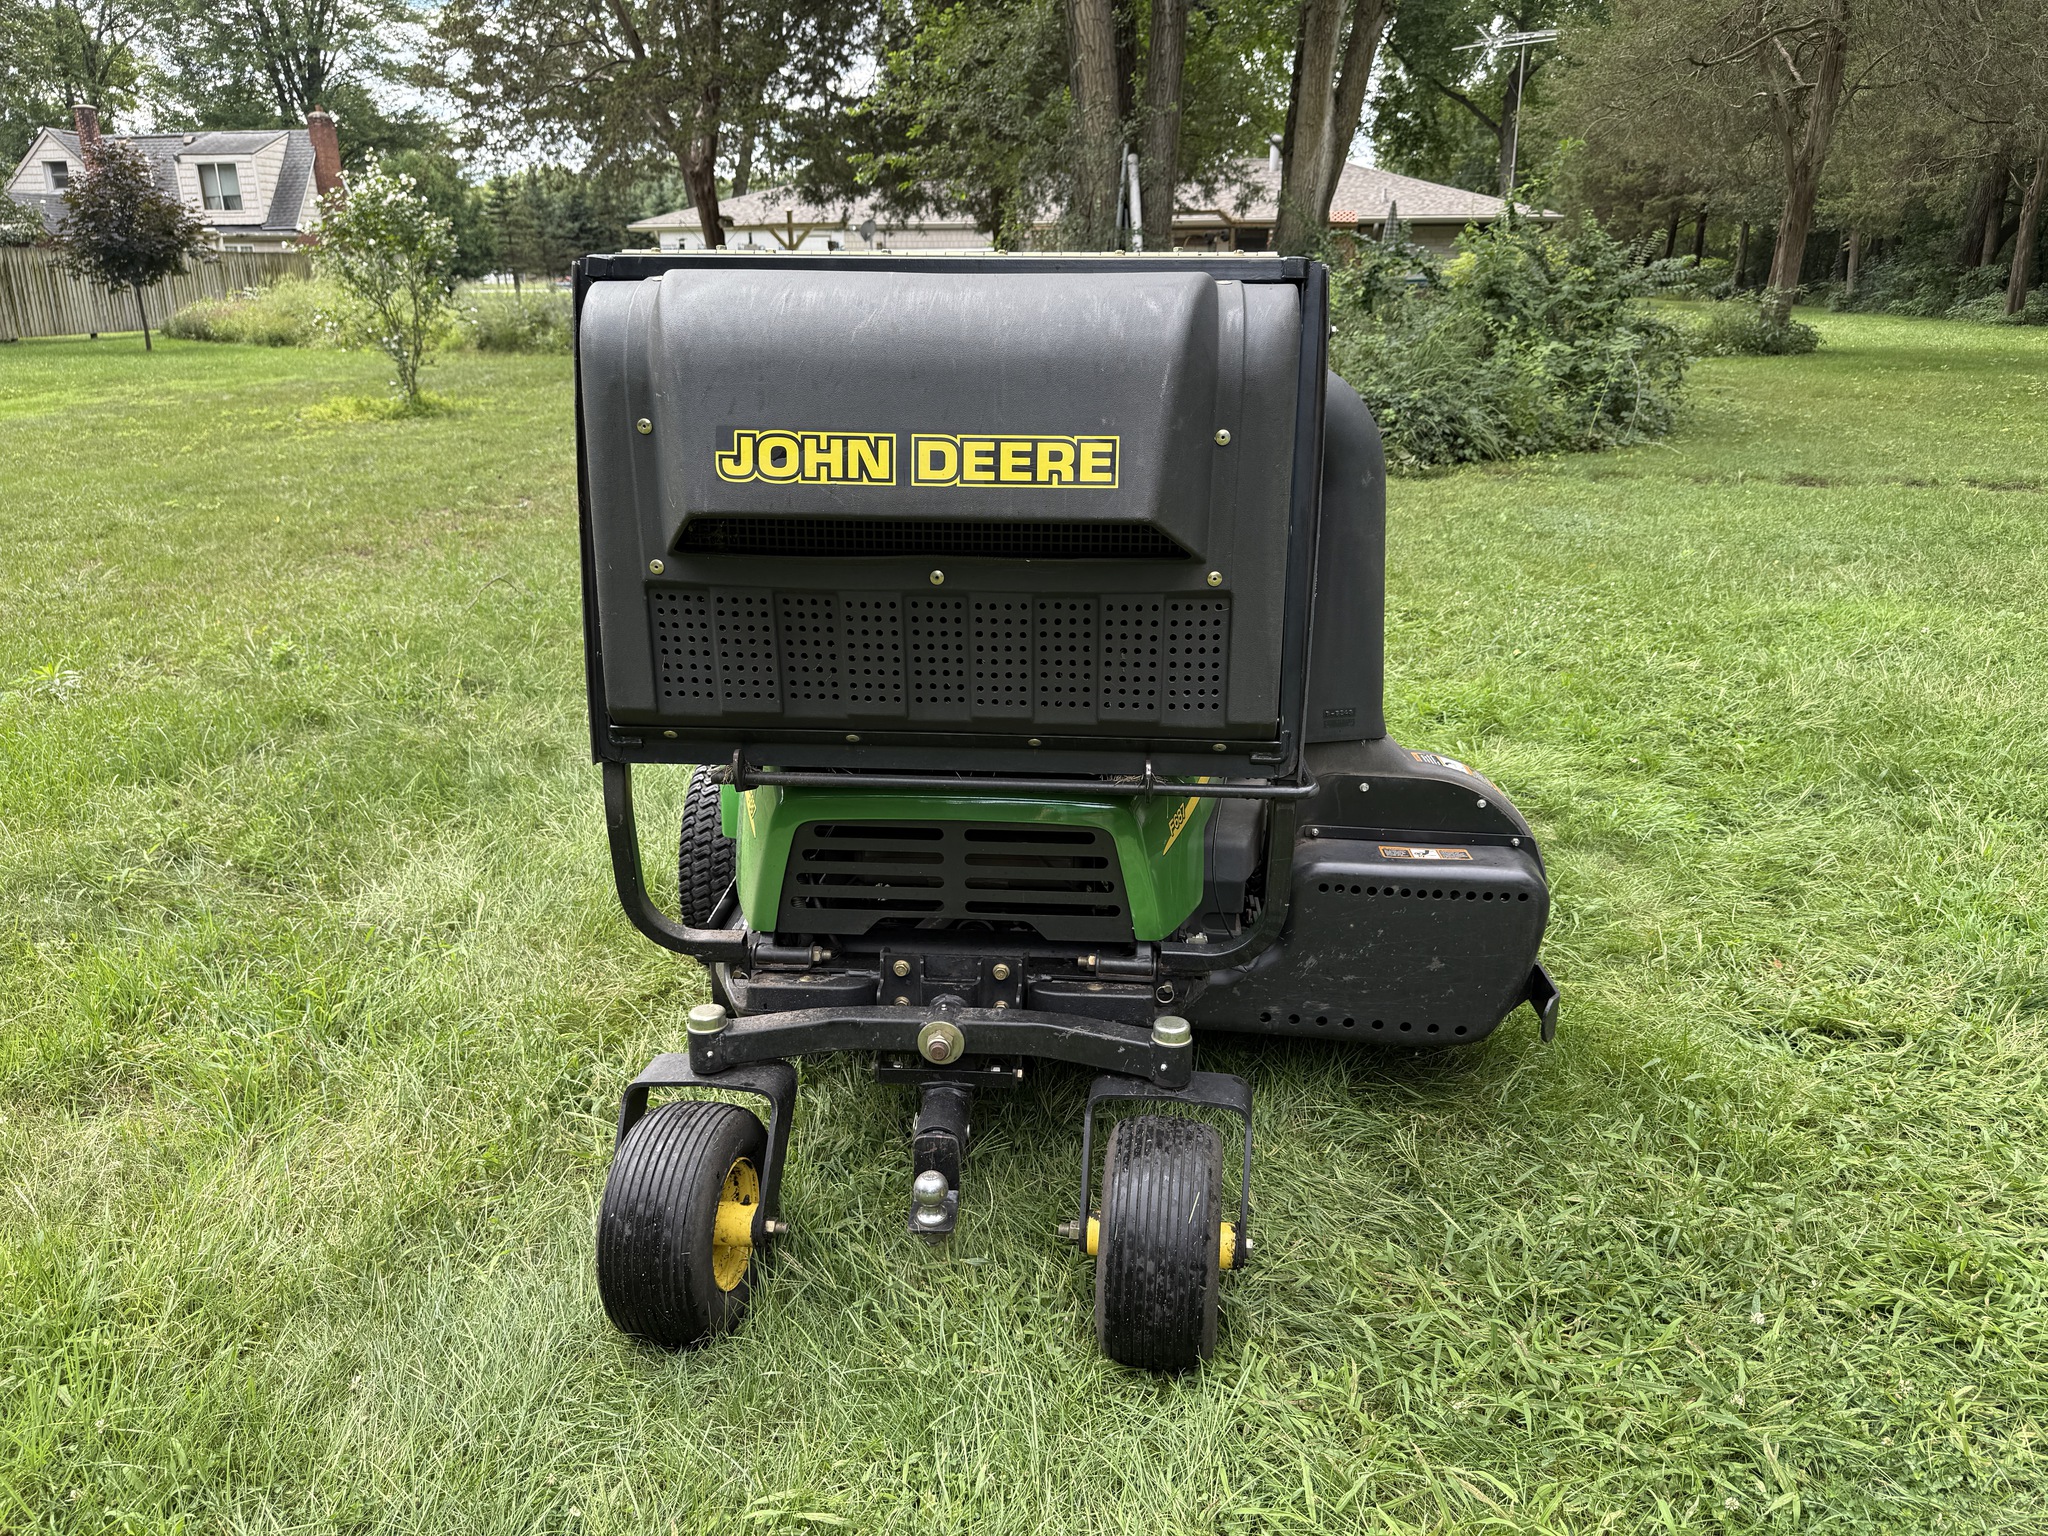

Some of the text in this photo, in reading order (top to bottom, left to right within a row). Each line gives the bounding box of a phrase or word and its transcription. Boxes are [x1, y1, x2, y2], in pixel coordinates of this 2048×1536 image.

[717, 432, 1119, 487] JOHN DEERE
[1167, 802, 1186, 838] F687
